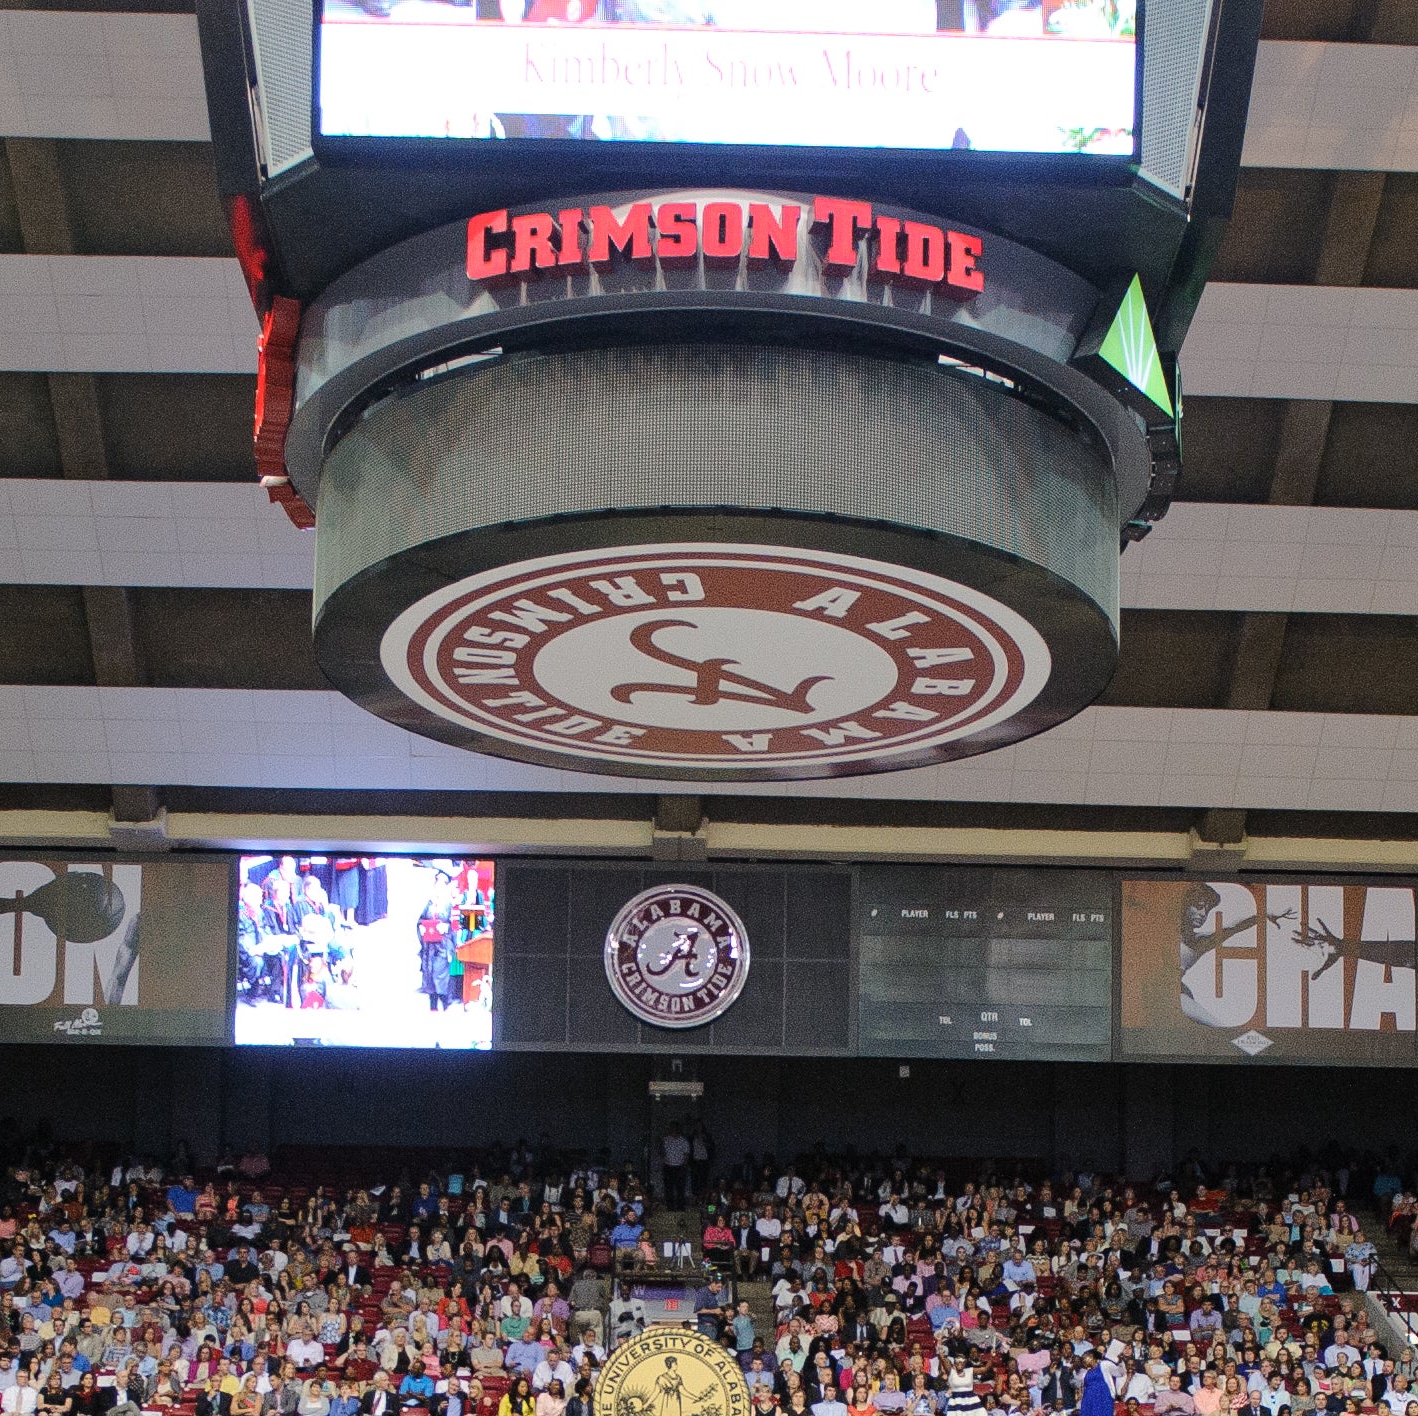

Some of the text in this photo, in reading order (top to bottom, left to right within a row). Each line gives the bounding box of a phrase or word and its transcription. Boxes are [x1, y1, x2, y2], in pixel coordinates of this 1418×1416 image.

[524, 42, 940, 94] Kimberly Snow Moore
[465, 196, 985, 293] CRIMSON TIDE
[721, 586, 976, 755] ALABAMA
[623, 899, 731, 948] ALABAMA
[901, 909, 929, 919] PLAYER
[963, 910, 978, 920] PTS
[1027, 912, 1055, 922] PLAYER
[1090, 914, 1104, 923] PTS
[622, 962, 733, 1012] CRIMSON TIDE
[604, 1337, 692, 1395] UNIVERSITY
[694, 1343, 714, 1360] OF
